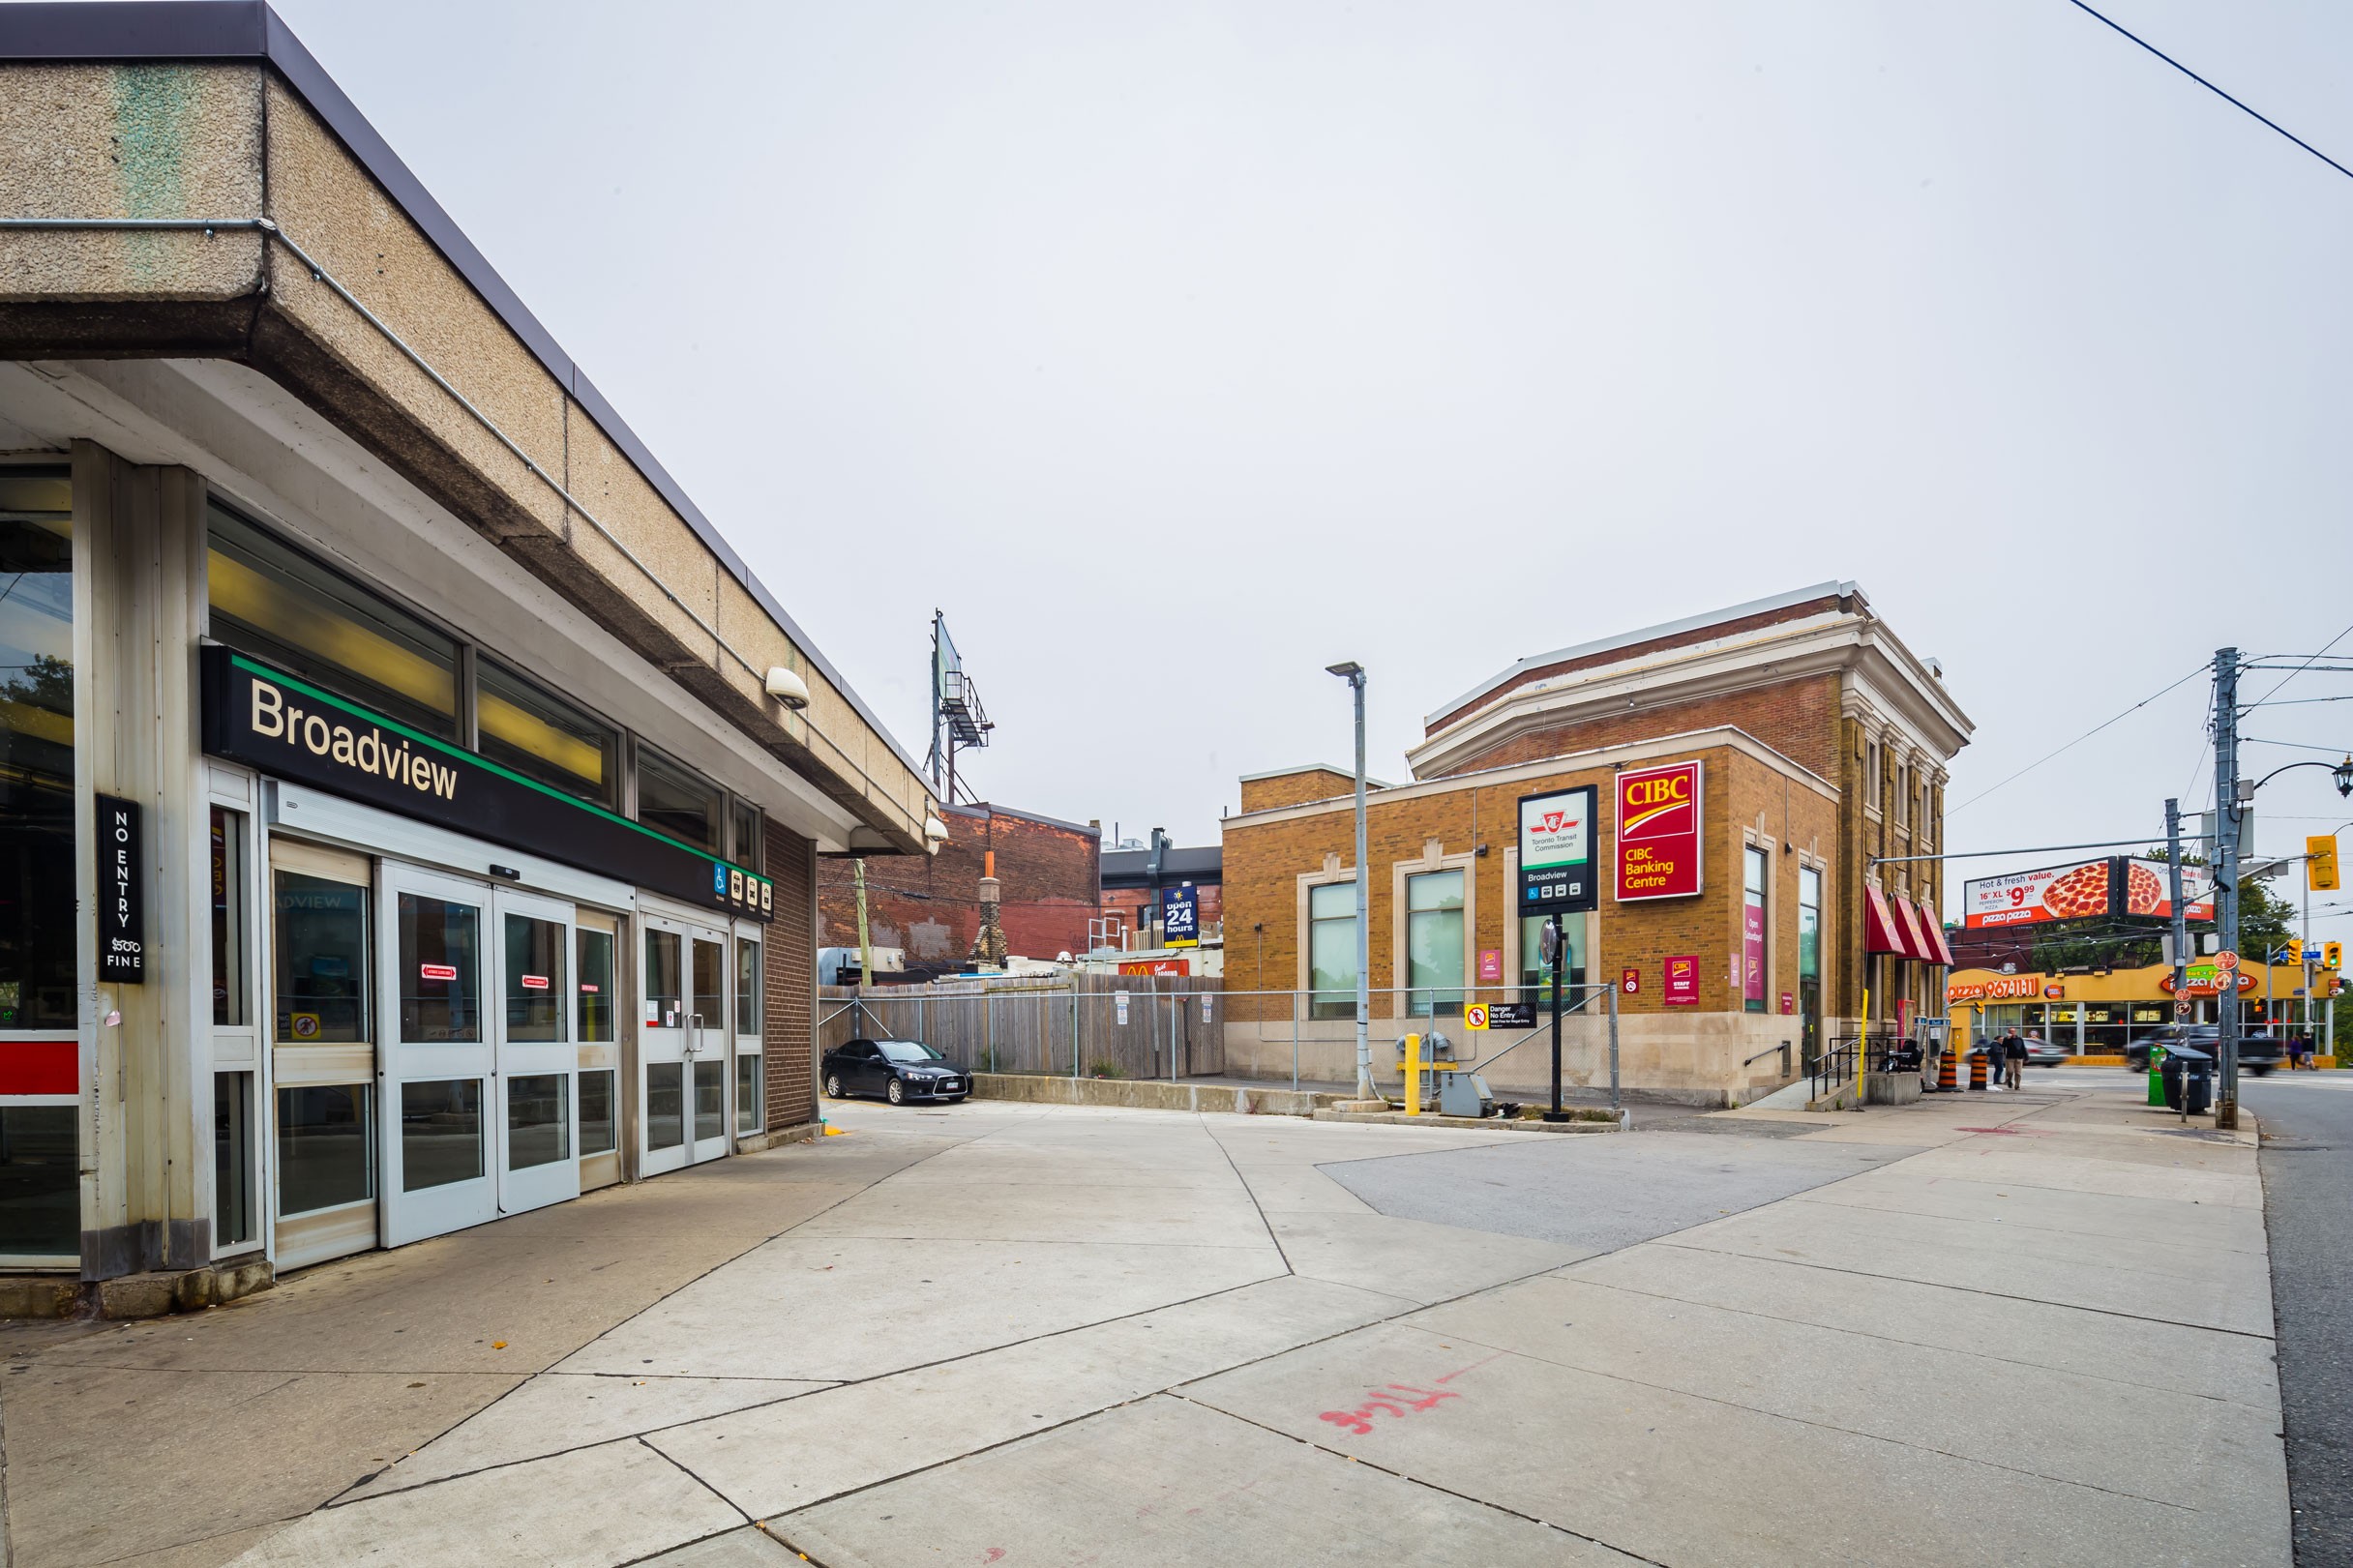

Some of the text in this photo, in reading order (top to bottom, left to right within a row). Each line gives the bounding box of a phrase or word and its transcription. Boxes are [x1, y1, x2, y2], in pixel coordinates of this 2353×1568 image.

[252, 678, 458, 800] Broadview
[1625, 775, 1689, 807] CIBC
[115, 811, 129, 843] NO
[1532, 834, 1577, 845] Toronto Transit
[1534, 842, 1574, 852] Commission
[1625, 846, 1653, 862] CIBC
[1625, 860, 1674, 875] Banking
[1528, 871, 1567, 882] Broadview
[1625, 875, 1667, 889] Centre
[1980, 871, 2055, 890] Hot & fresh value.
[116, 849, 130, 928] ENTRY
[1993, 890, 2003, 899] XL
[1167, 901, 1192, 911] open
[1167, 908, 1193, 926] 24
[1748, 918, 1759, 930] Open
[1982, 910, 2031, 926] pizza pizza
[1167, 925, 1194, 933] hours
[106, 955, 141, 968] FINE
[1948, 985, 1983, 1004] pizza
